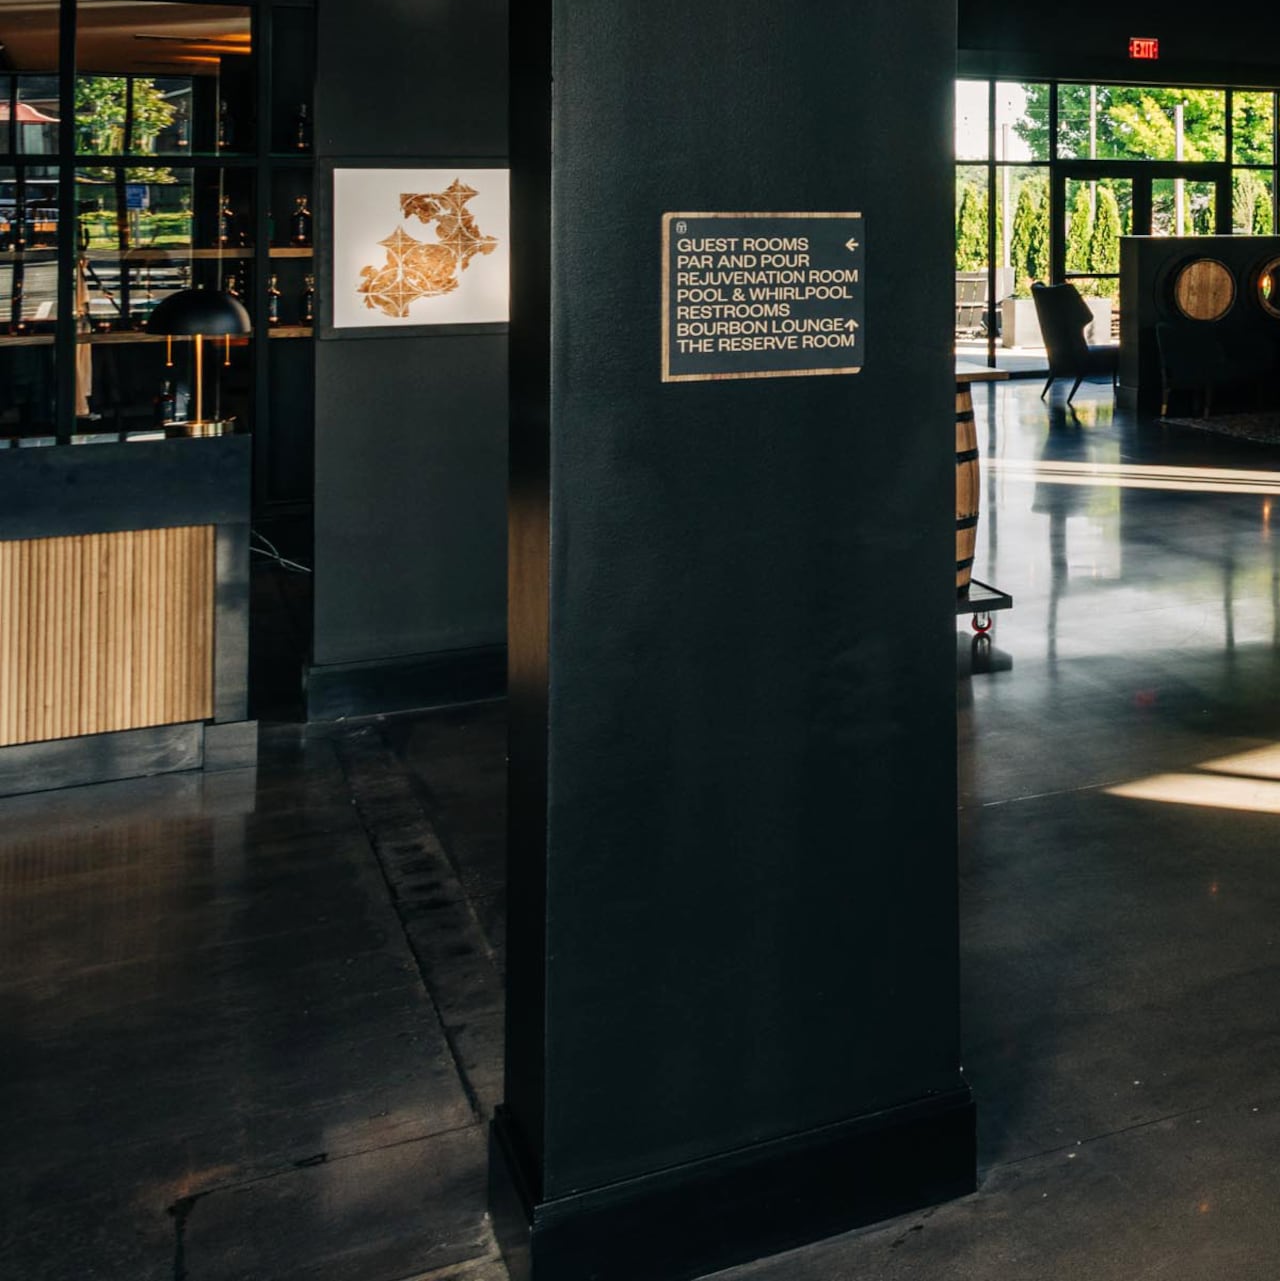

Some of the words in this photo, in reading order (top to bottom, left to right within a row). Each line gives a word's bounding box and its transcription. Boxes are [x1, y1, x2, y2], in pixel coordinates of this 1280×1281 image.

[1133, 40, 1154, 58] EXIT
[677, 238, 739, 252] GUEST
[743, 237, 808, 251] ROOMS
[677, 255, 713, 269] PAR
[717, 255, 756, 268] AND
[761, 254, 809, 268] POUR
[677, 271, 805, 286] REJUVENATION
[809, 269, 858, 283] ROOM
[677, 288, 728, 302] POOL
[732, 287, 746, 301] &
[749, 286, 853, 301] WHIRLPOOL
[677, 303, 790, 319] RESTROOMS
[677, 321, 767, 336] BOURBON
[772, 318, 844, 333] LOUNGE
[676, 338, 714, 353] THE
[718, 336, 798, 352] RESERVE
[802, 334, 855, 348] ROOM
